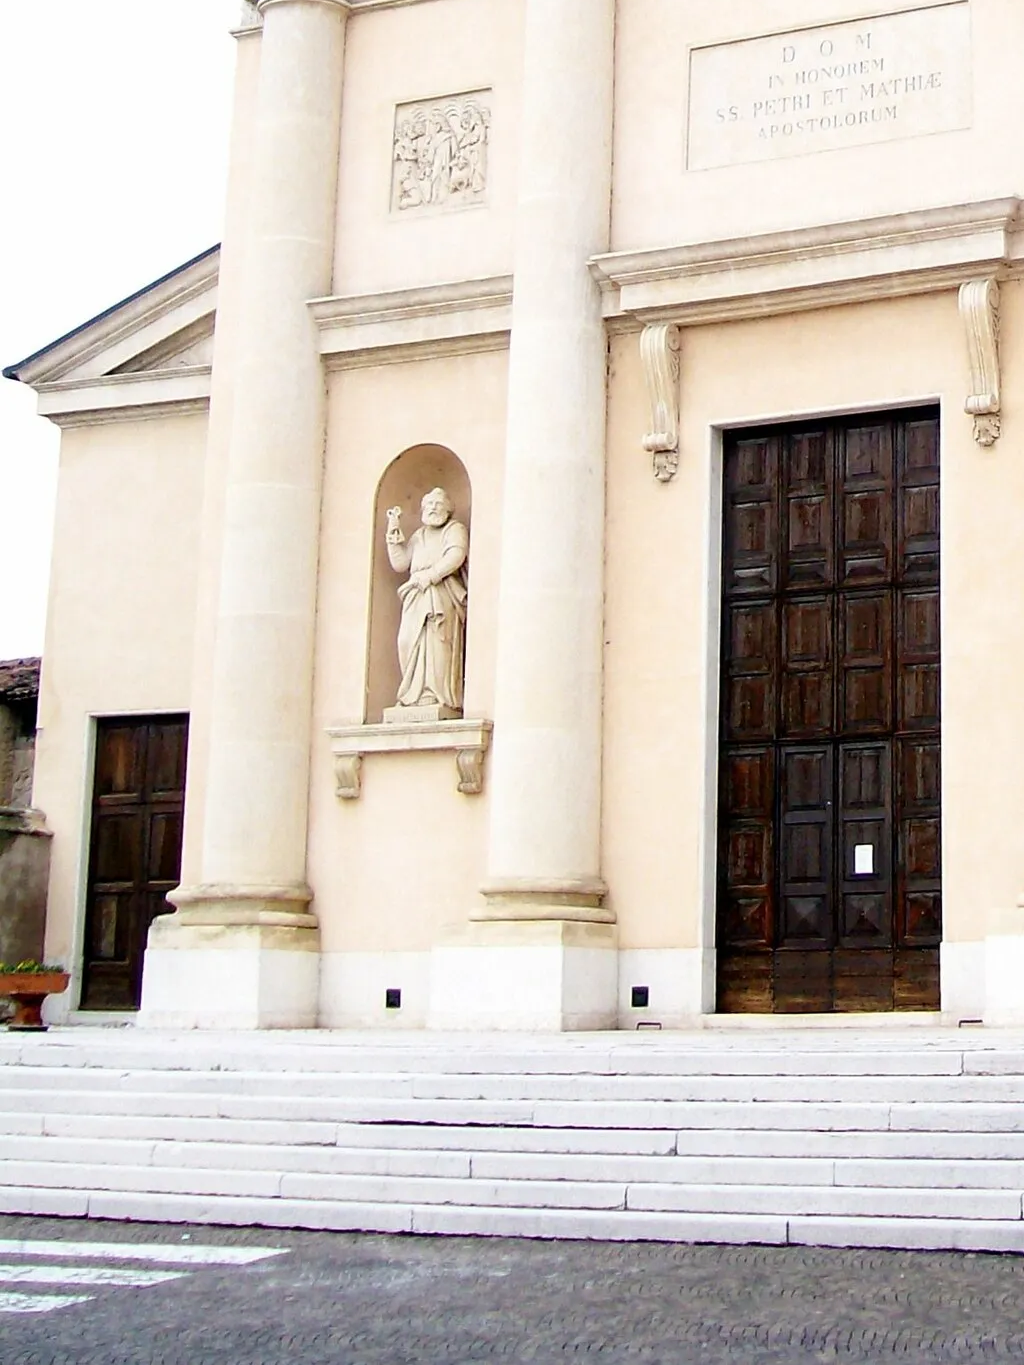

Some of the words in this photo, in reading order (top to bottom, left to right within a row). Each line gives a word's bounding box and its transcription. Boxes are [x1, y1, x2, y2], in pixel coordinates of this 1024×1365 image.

[782, 46, 796, 64] D
[819, 39, 834, 58] O
[856, 32, 872, 50] M
[768, 74, 786, 90] IN
[795, 57, 885, 84] HONOREM
[753, 93, 811, 119] PETRI
[822, 87, 849, 105] ET
[860, 72, 943, 101] MATHIÆ
[758, 105, 898, 140] APOSTOLORUM
